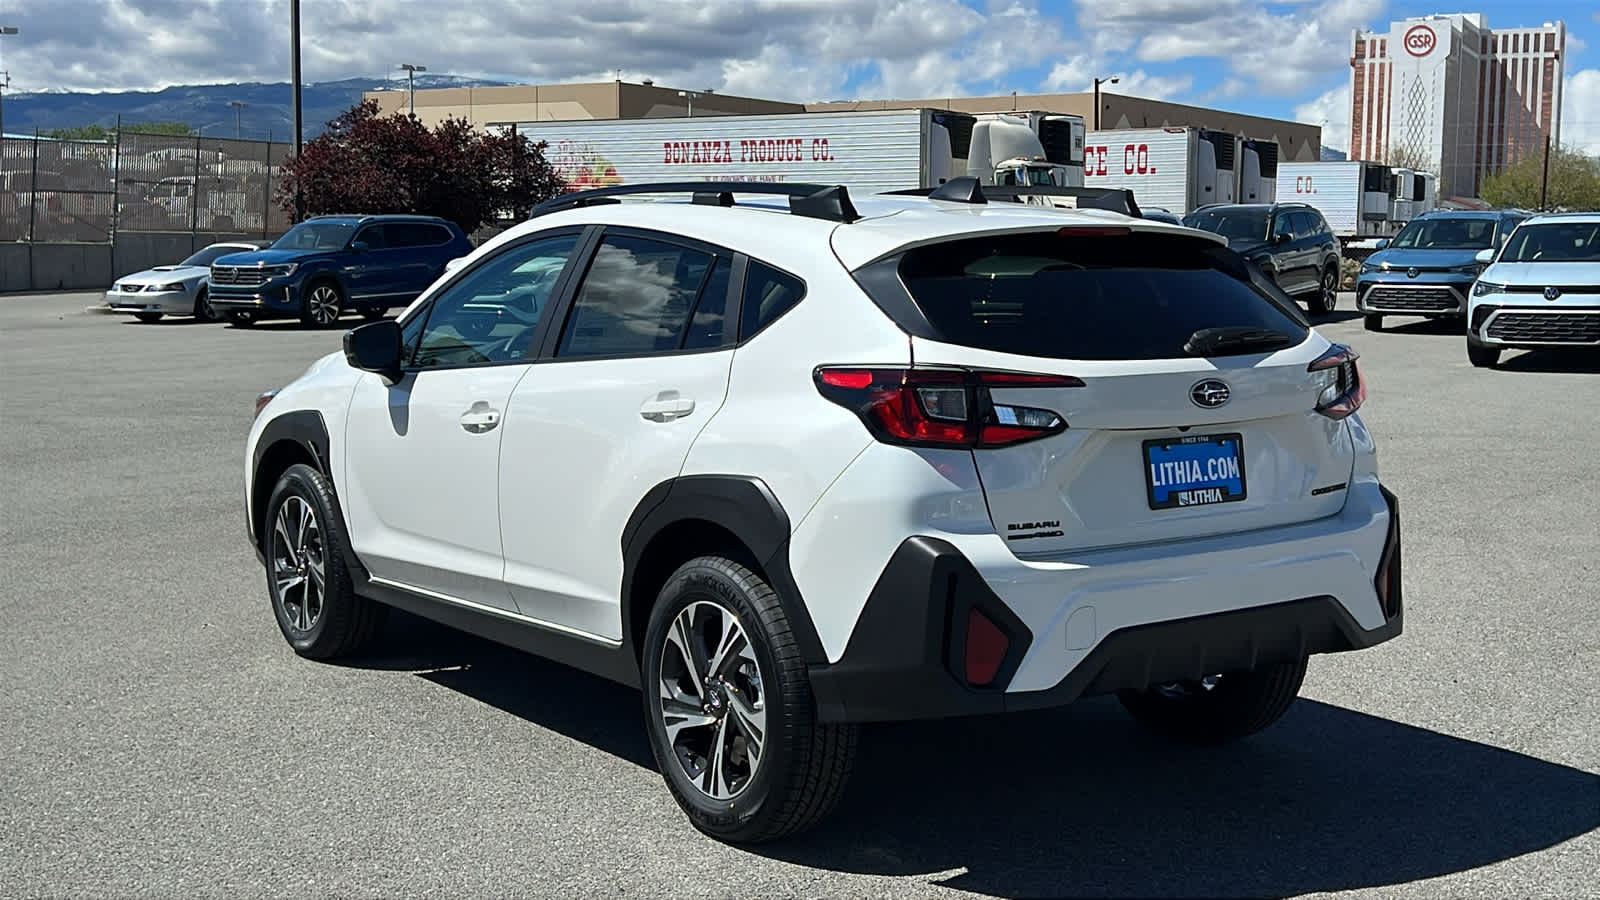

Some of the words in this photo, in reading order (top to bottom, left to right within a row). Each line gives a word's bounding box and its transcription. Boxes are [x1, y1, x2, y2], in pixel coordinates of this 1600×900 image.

[1408, 34, 1432, 48] GSR
[664, 141, 733, 163] BONANZA
[741, 139, 803, 162] PRODUCE
[812, 138, 834, 161] CO.
[1124, 144, 1156, 174] CO.
[1296, 176, 1317, 193] CO.
[1151, 456, 1240, 486] LITHIA.COM
[1189, 488, 1223, 504] LITHIA
[1008, 520, 1060, 530] SUBARU
